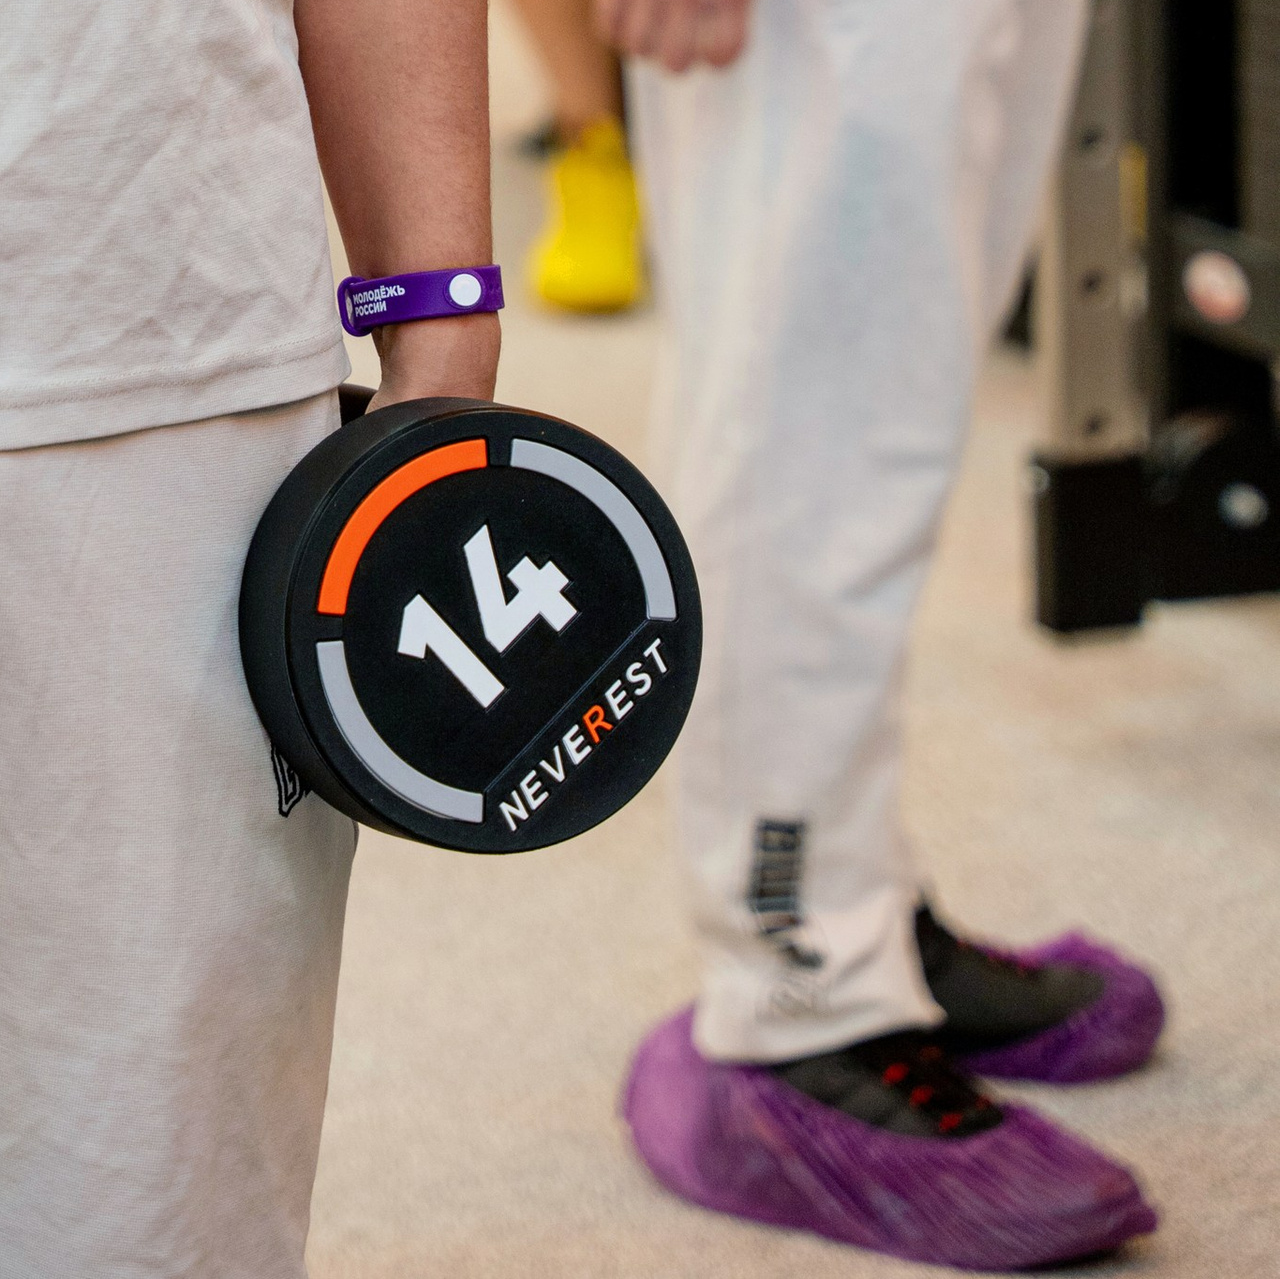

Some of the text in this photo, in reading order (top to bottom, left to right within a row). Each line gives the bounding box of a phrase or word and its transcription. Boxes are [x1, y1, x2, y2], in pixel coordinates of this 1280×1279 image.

[352, 284, 406, 305] МОЛОДЁЖЬ
[354, 300, 387, 317] РОССИИ
[397, 524, 578, 709] 14
[498, 638, 673, 832] NEVEREST
